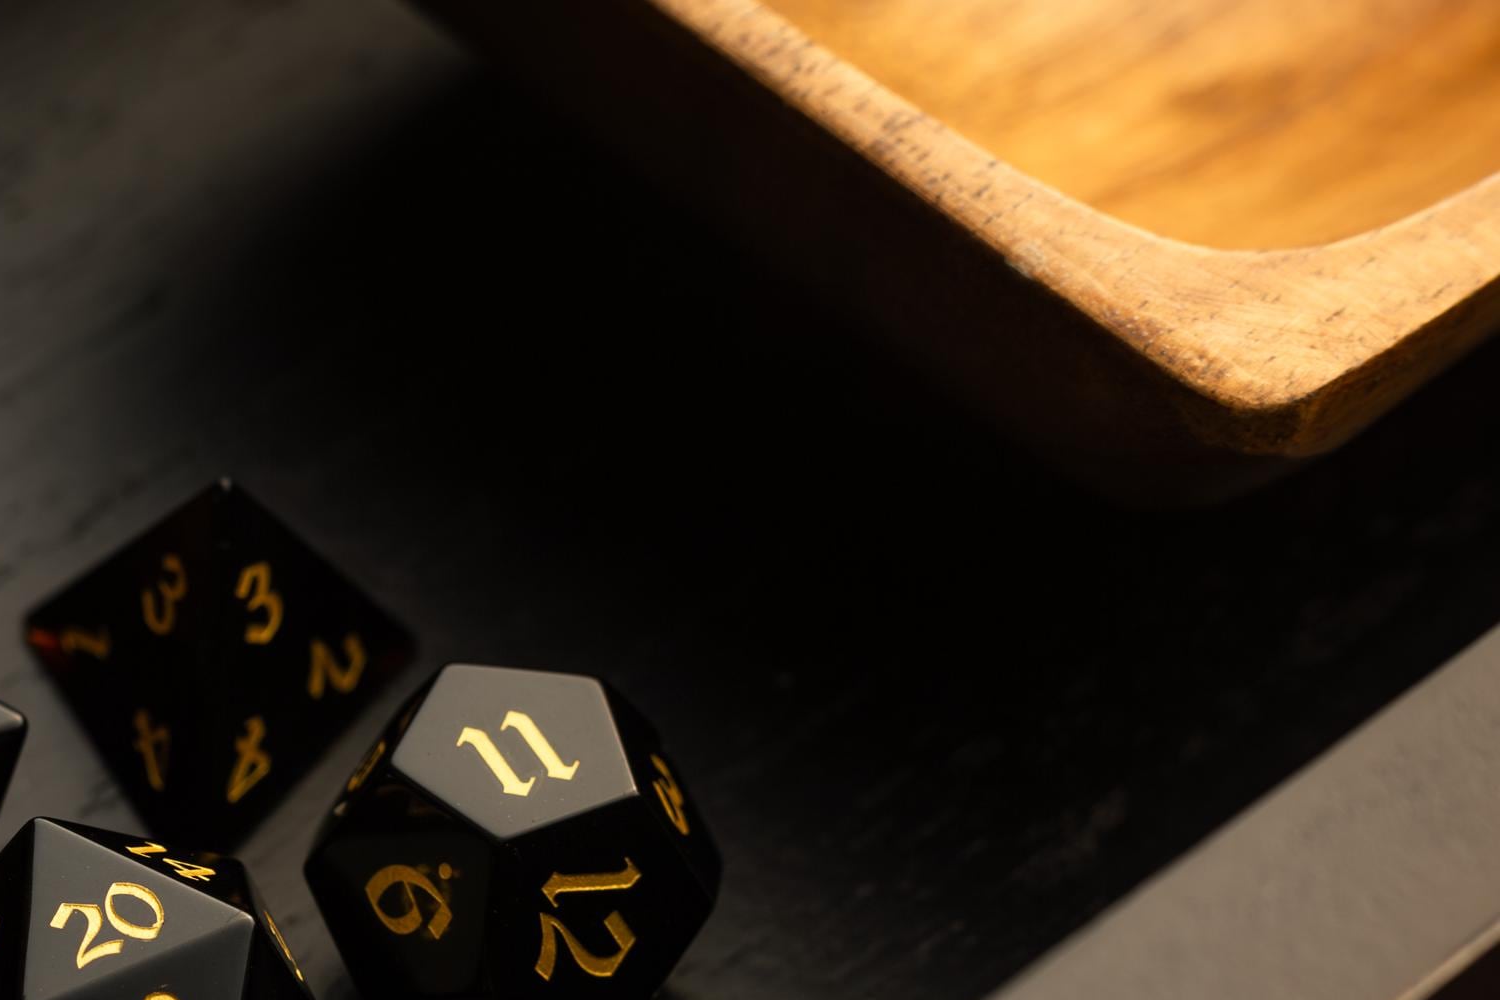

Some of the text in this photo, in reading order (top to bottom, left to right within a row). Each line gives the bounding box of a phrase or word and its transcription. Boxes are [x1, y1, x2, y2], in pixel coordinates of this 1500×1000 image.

[235, 562, 284, 646] 3
[307, 635, 367, 699] 2
[226, 717, 271, 803] 4
[453, 707, 583, 800] 11
[48, 879, 167, 971] 20
[533, 859, 642, 982] 12
